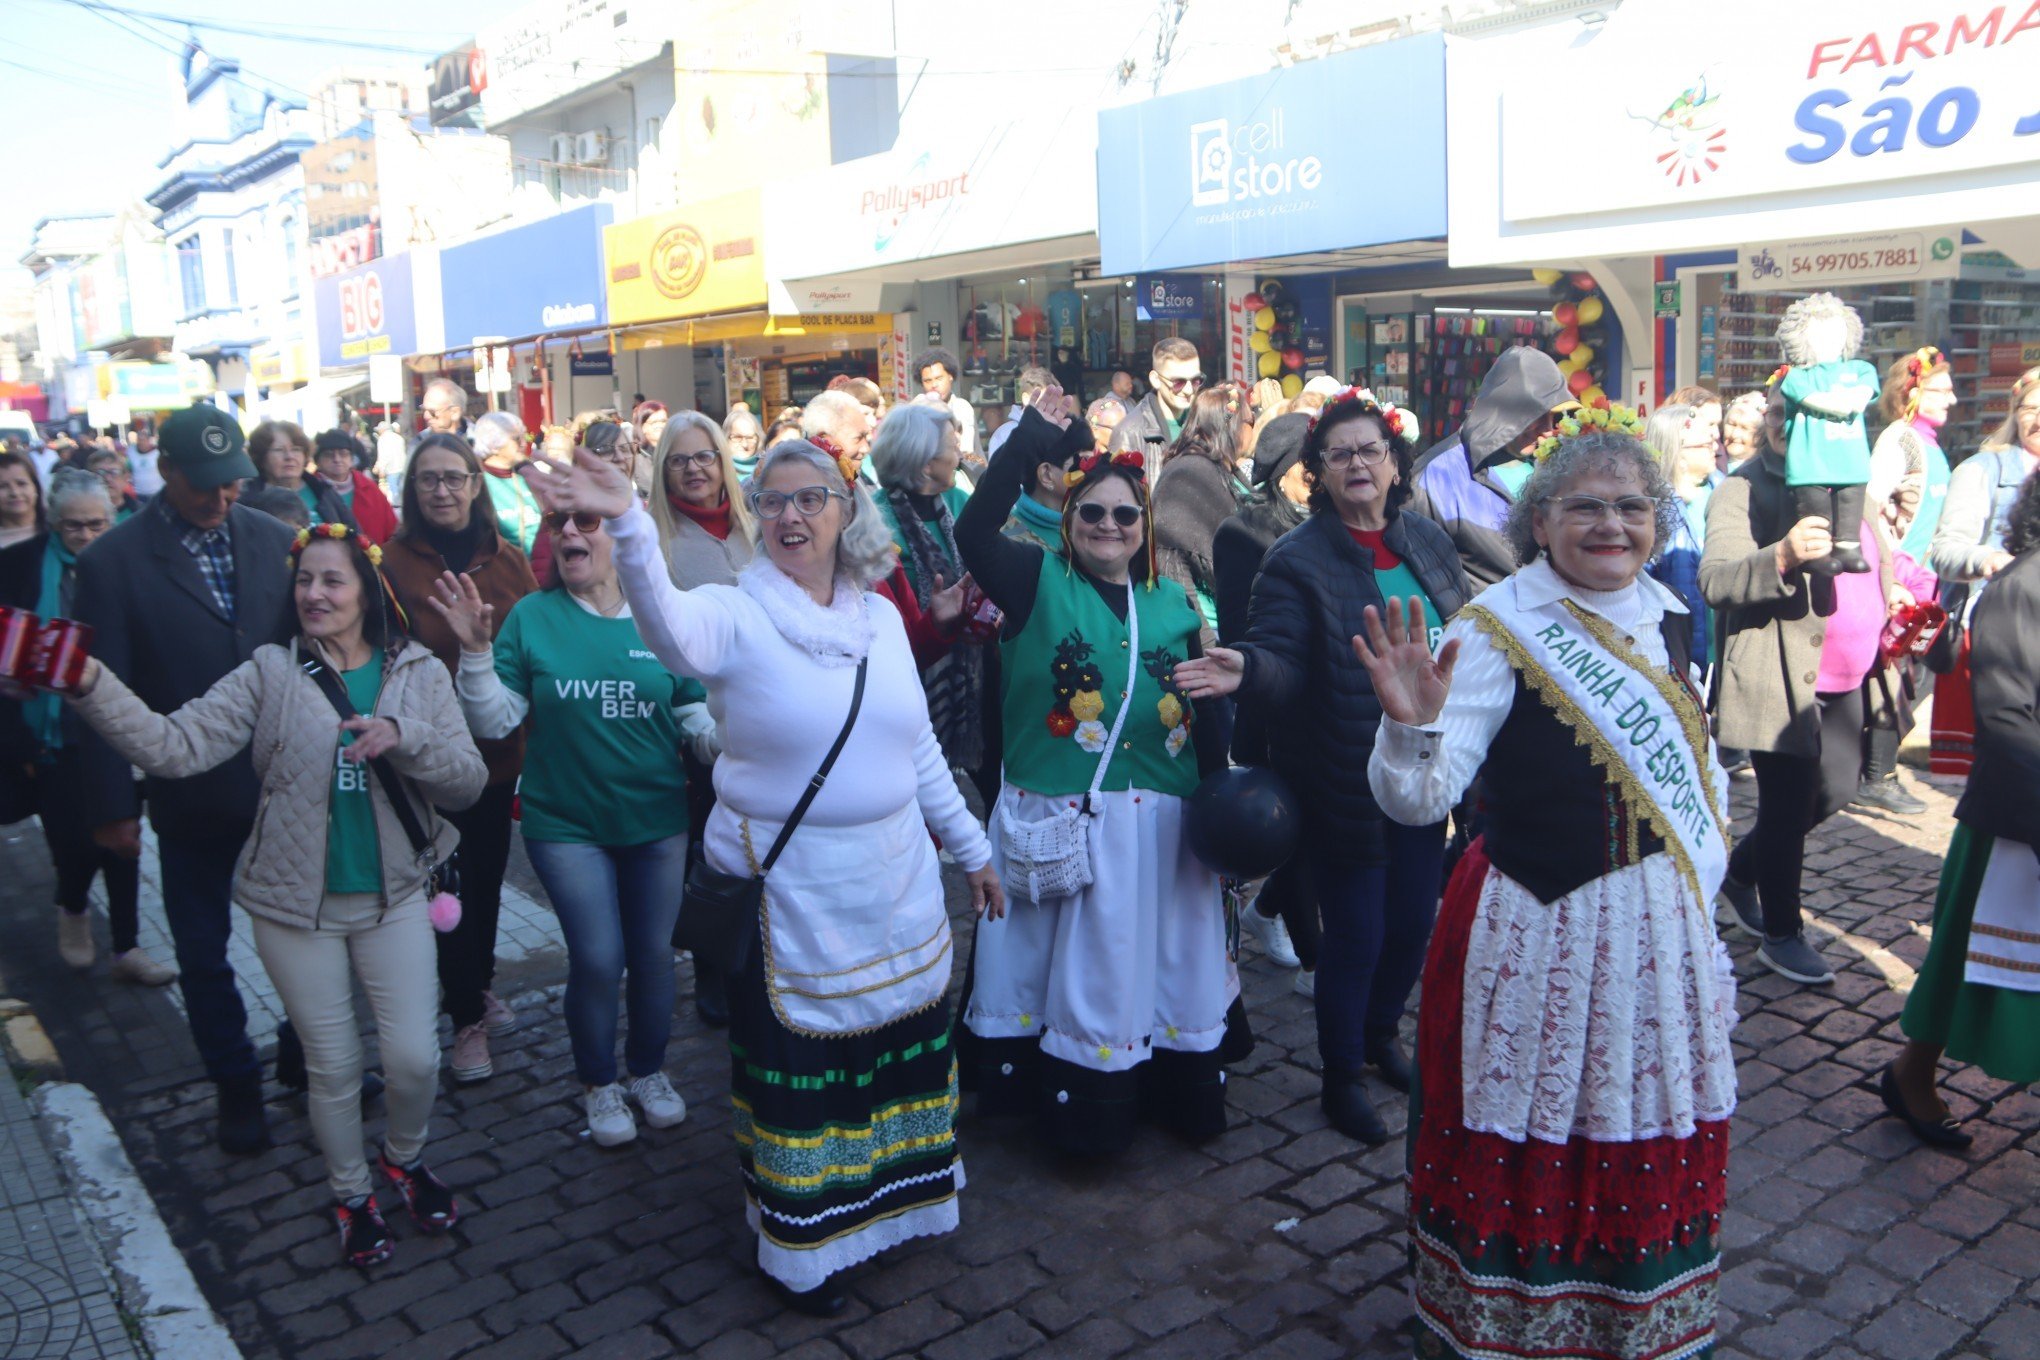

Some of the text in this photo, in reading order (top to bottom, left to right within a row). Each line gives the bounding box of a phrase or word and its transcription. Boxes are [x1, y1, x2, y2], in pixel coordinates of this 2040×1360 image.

[1806, 0, 2040, 80] FARMA
[1234, 106, 1284, 155] cell
[1785, 70, 1981, 165] São
[861, 171, 969, 215] Pollysport
[1233, 155, 1323, 201] store
[1791, 247, 1919, 274] 54 99705.7881
[339, 271, 384, 339] BIG
[800, 315, 874, 325] GOOL DE PLACA BAR
[1165, 293, 1194, 307] store
[555, 679, 636, 700] VIVER
[602, 700, 657, 719] BEM
[1535, 622, 1711, 850] RAINHA DO ESPORTE
